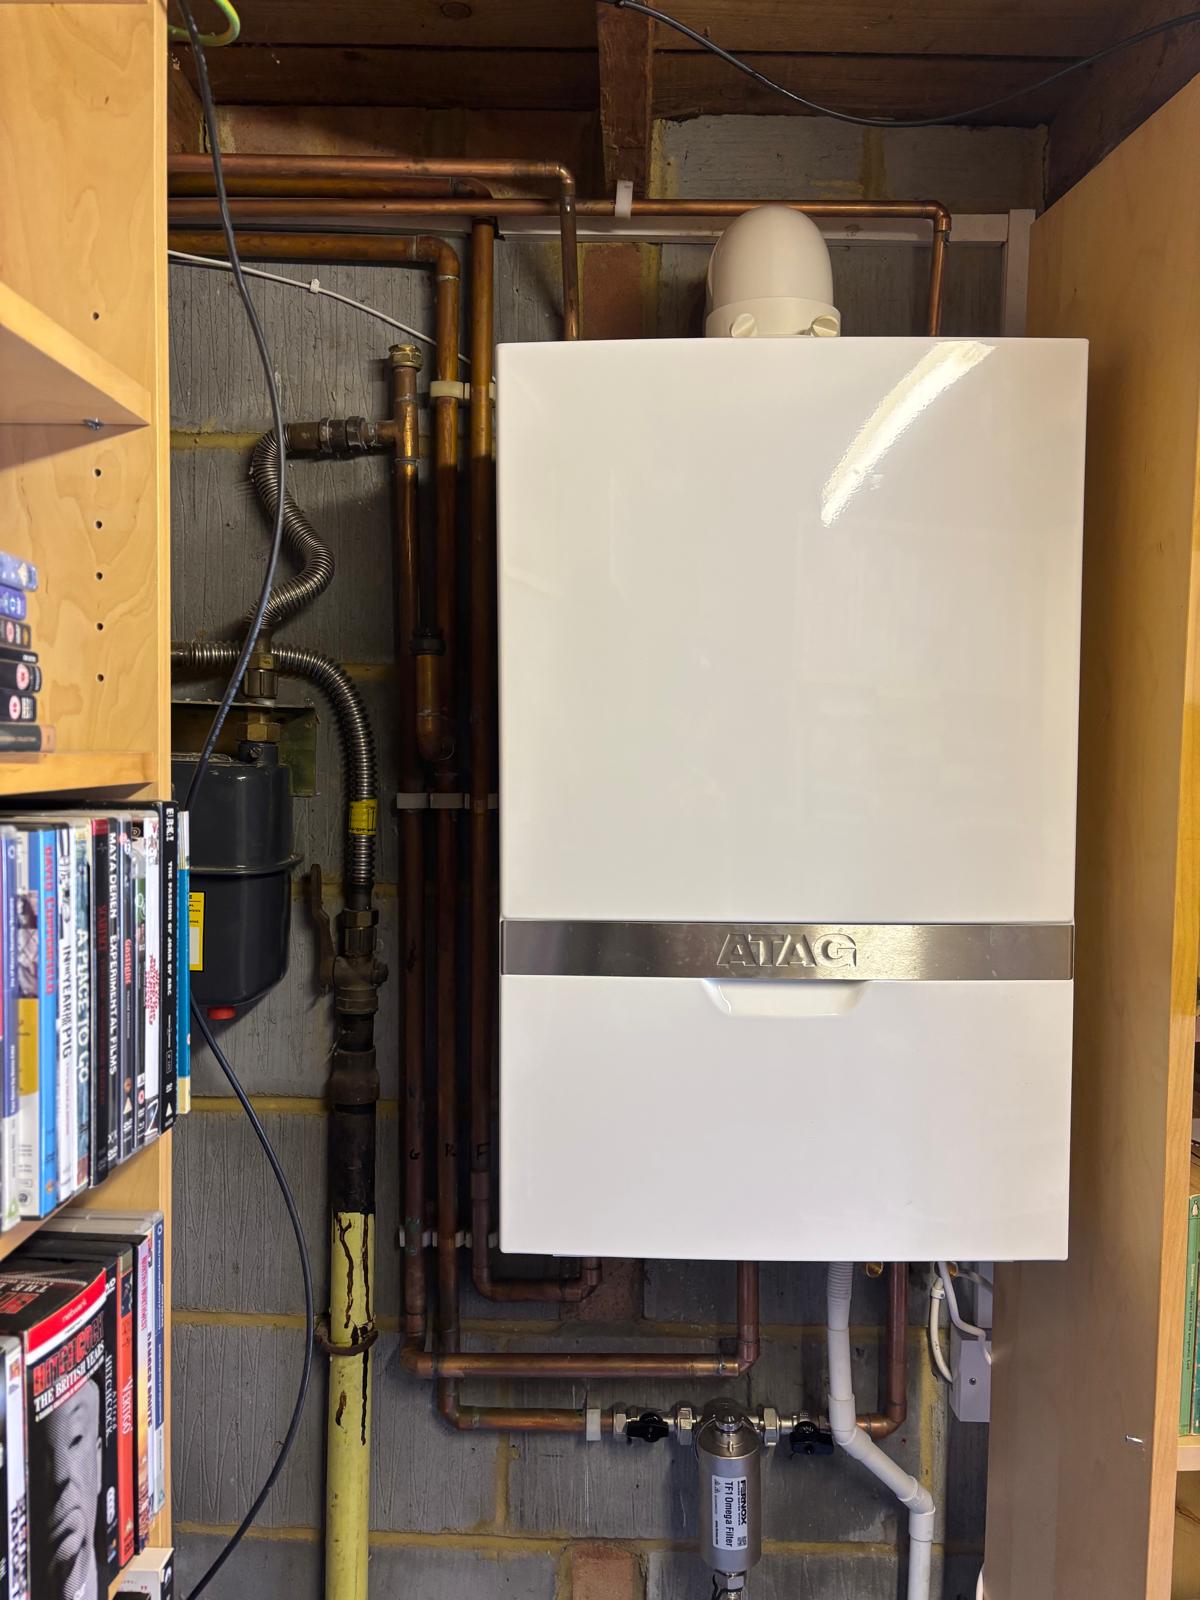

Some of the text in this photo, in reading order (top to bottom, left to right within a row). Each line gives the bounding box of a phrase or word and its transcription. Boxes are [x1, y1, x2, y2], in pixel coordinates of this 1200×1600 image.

[45, 846, 54, 891] DAVID
[108, 833, 118, 919] MAYA DEREN
[167, 923, 173, 934] OF
[716, 933, 857, 968] ATAG
[167, 964, 173, 975] OF
[62, 978, 71, 1012] YEAR
[76, 928, 89, 1084] A PLACE TO GO
[109, 936, 118, 1075] EXPERIMENTAL FILMS
[62, 1027, 72, 1059] PIG
[34, 1389, 54, 1410] THE
[55, 1364, 86, 1397] BRITISH
[723, 1481, 734, 1547] TF1 Omega Filter
